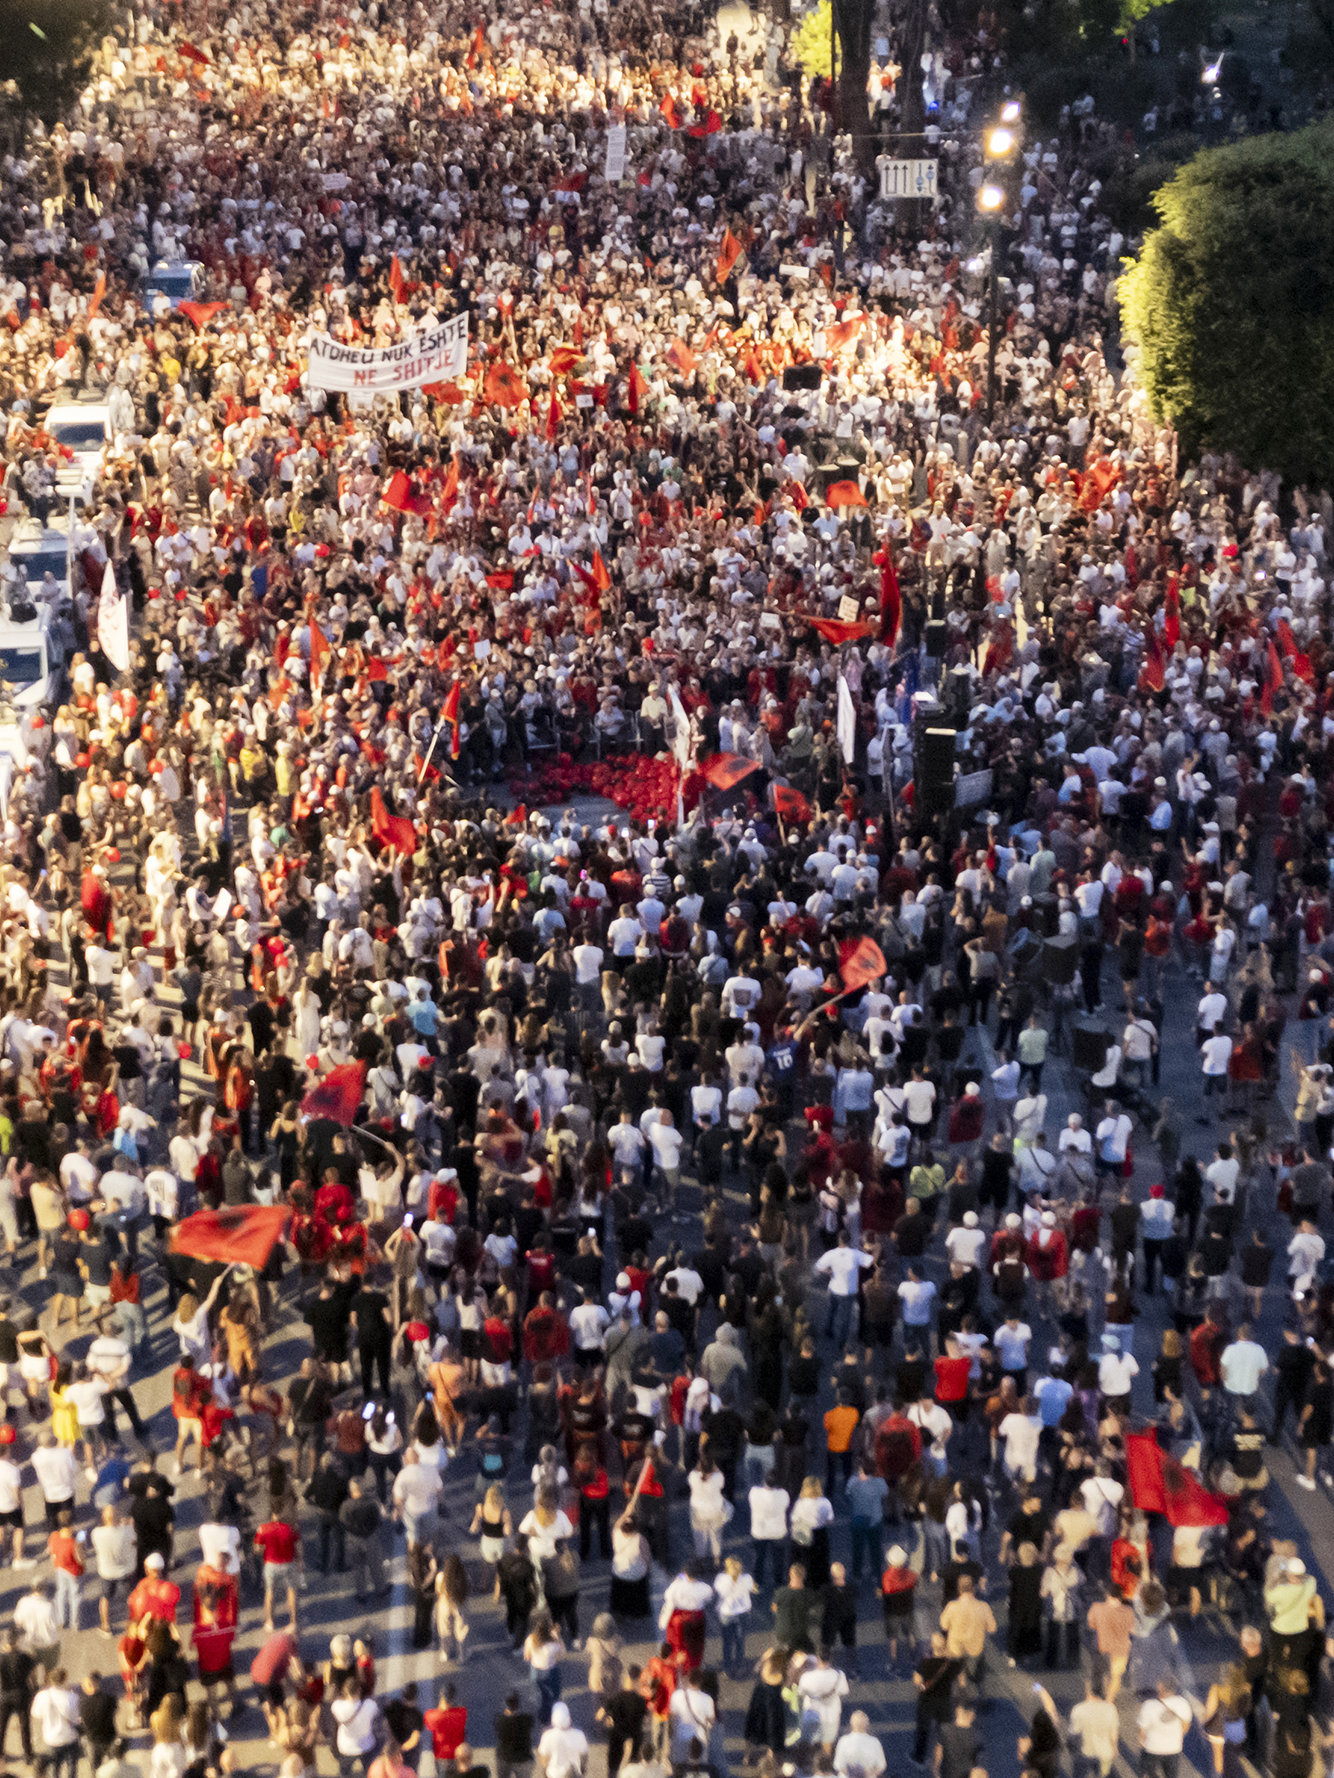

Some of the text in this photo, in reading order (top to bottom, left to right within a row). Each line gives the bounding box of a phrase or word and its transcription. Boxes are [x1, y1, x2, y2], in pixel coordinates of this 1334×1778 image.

[310, 338, 375, 364] ATDHEU
[381, 345, 413, 362] NUK
[393, 349, 453, 380] SHITJE
